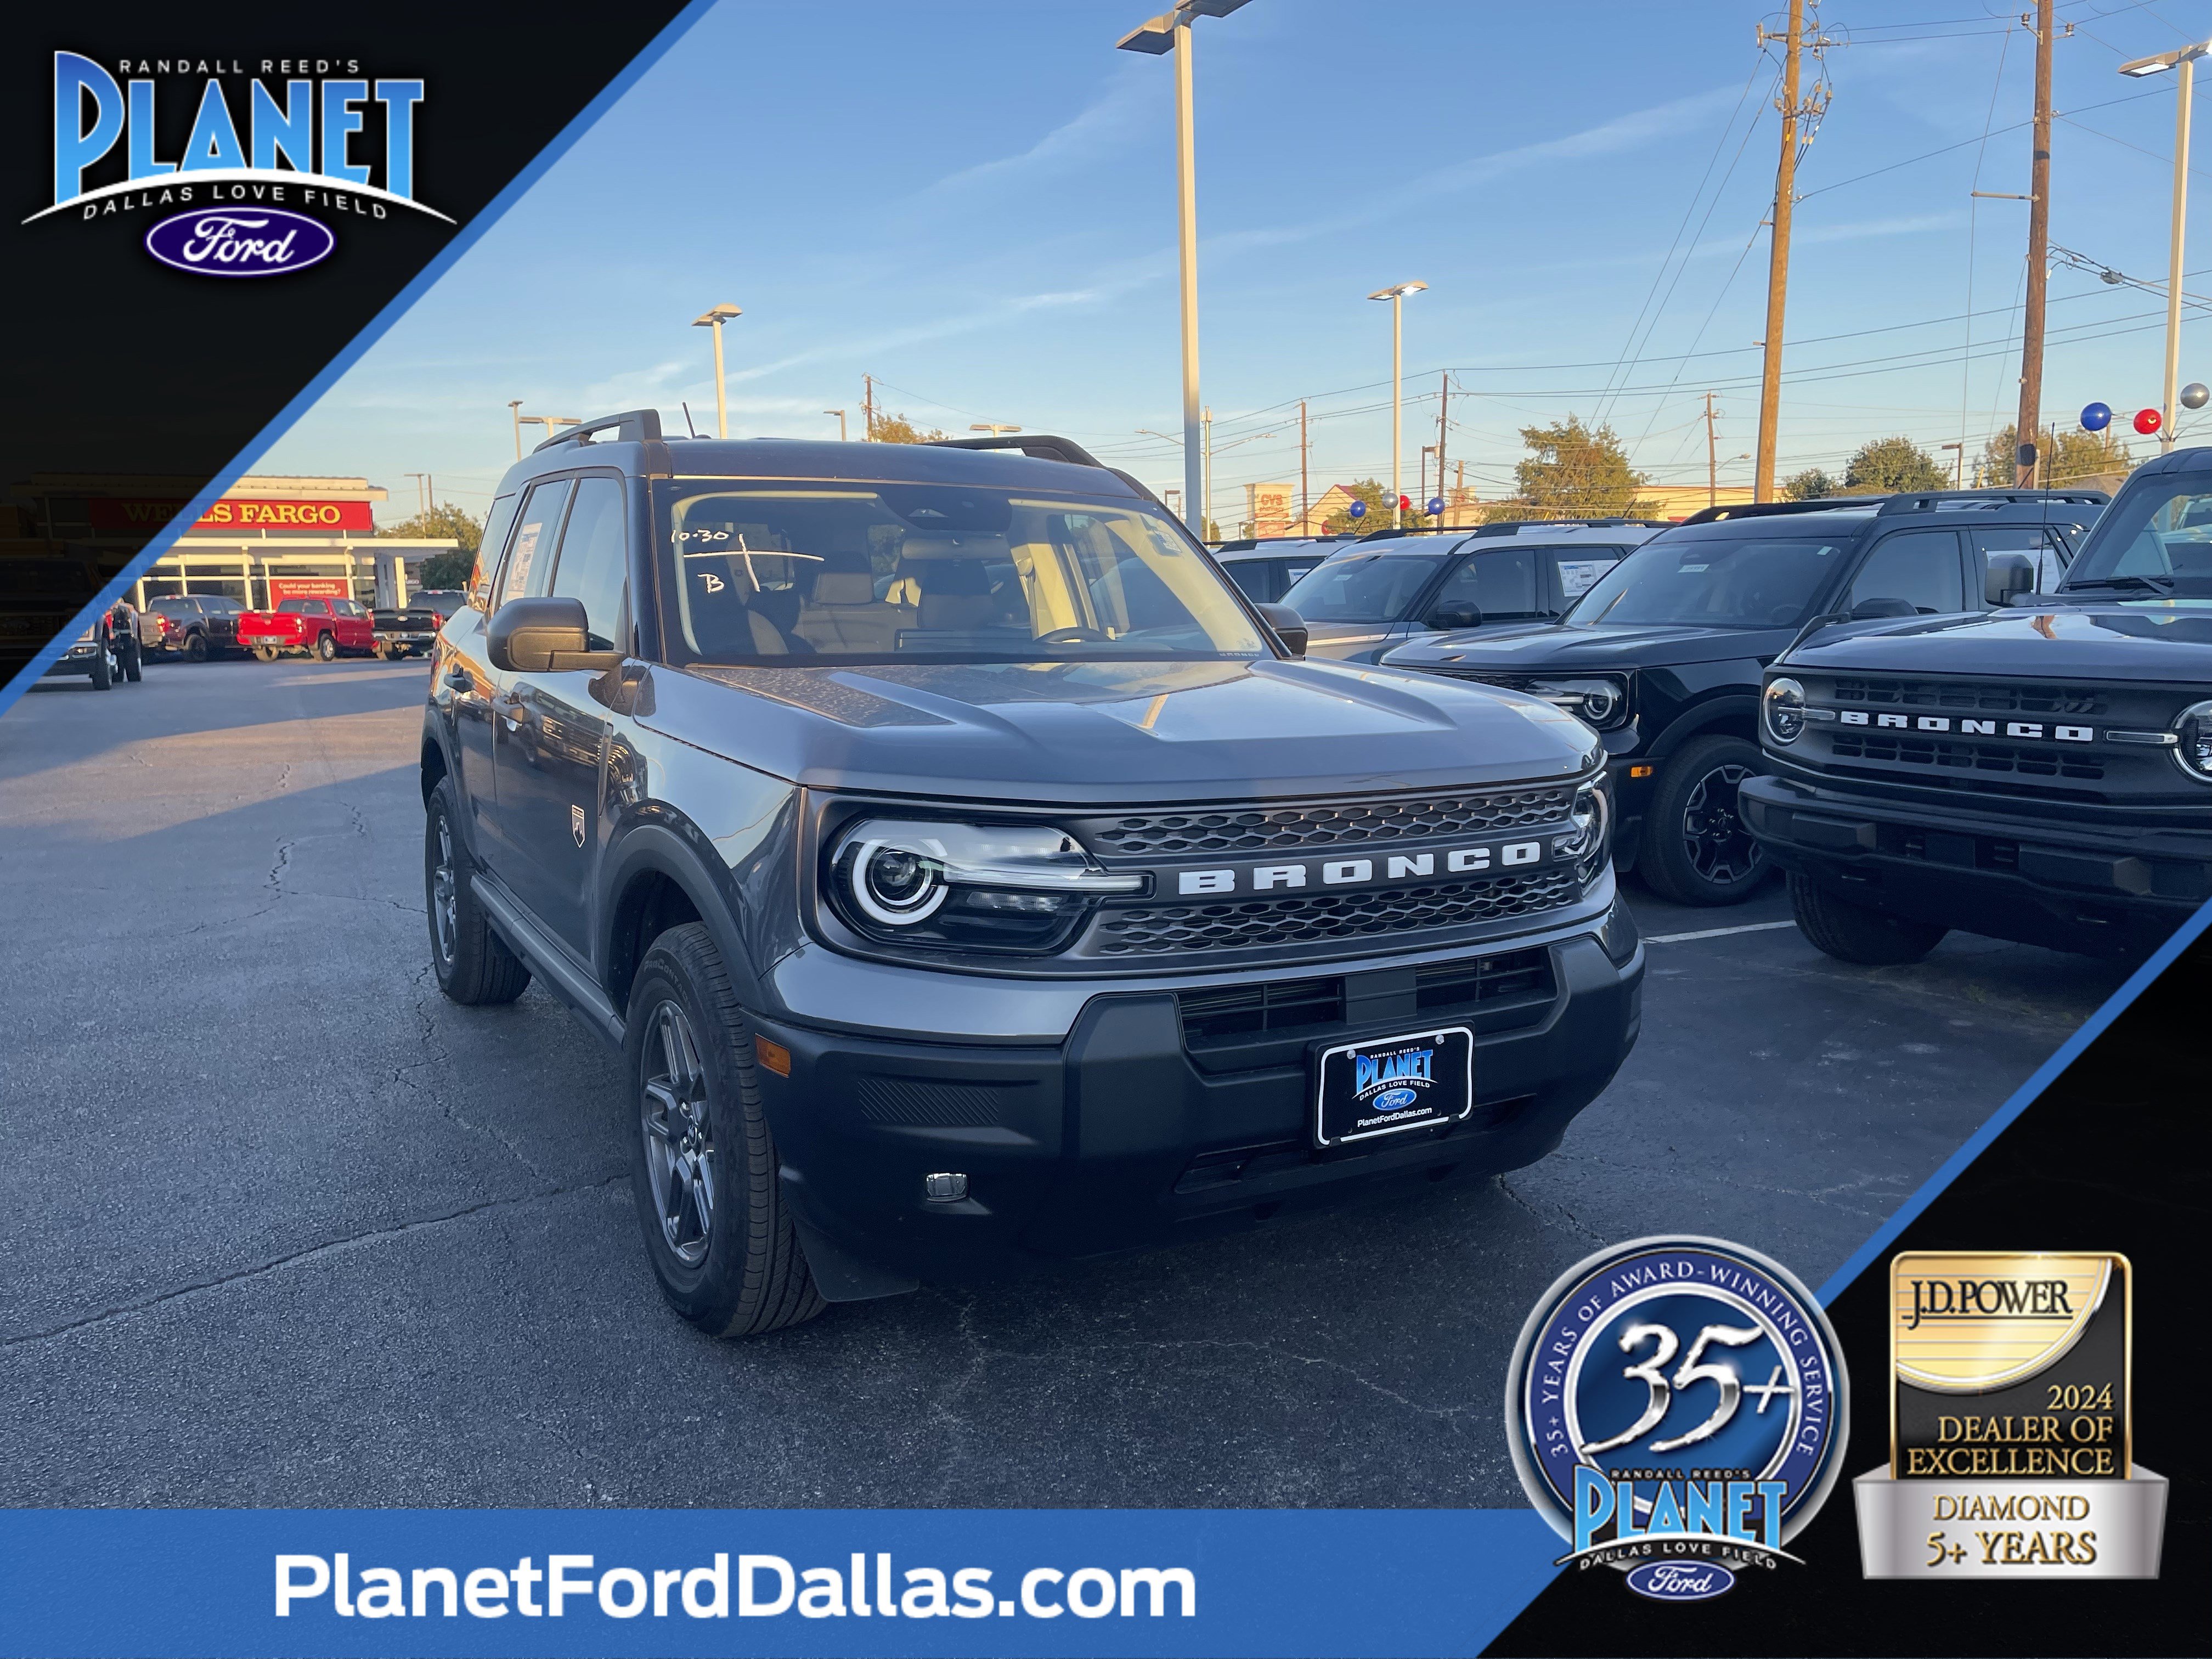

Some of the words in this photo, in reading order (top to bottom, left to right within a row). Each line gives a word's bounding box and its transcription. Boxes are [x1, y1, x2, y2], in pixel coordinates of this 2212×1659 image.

[1261, 494, 1283, 505] CVS
[238, 504, 342, 524] FARGO
[1841, 710, 2094, 742] BRONCO
[1177, 842, 1541, 896] BRONCO
[1370, 1051, 1397, 1059] RANDALL
[1356, 1049, 1433, 1095] PLANET
[1359, 1084, 1386, 1101] DALLAS
[1381, 1093, 1407, 1108] Ford
[1357, 1107, 1432, 1127] PlanetFordDallas.com
